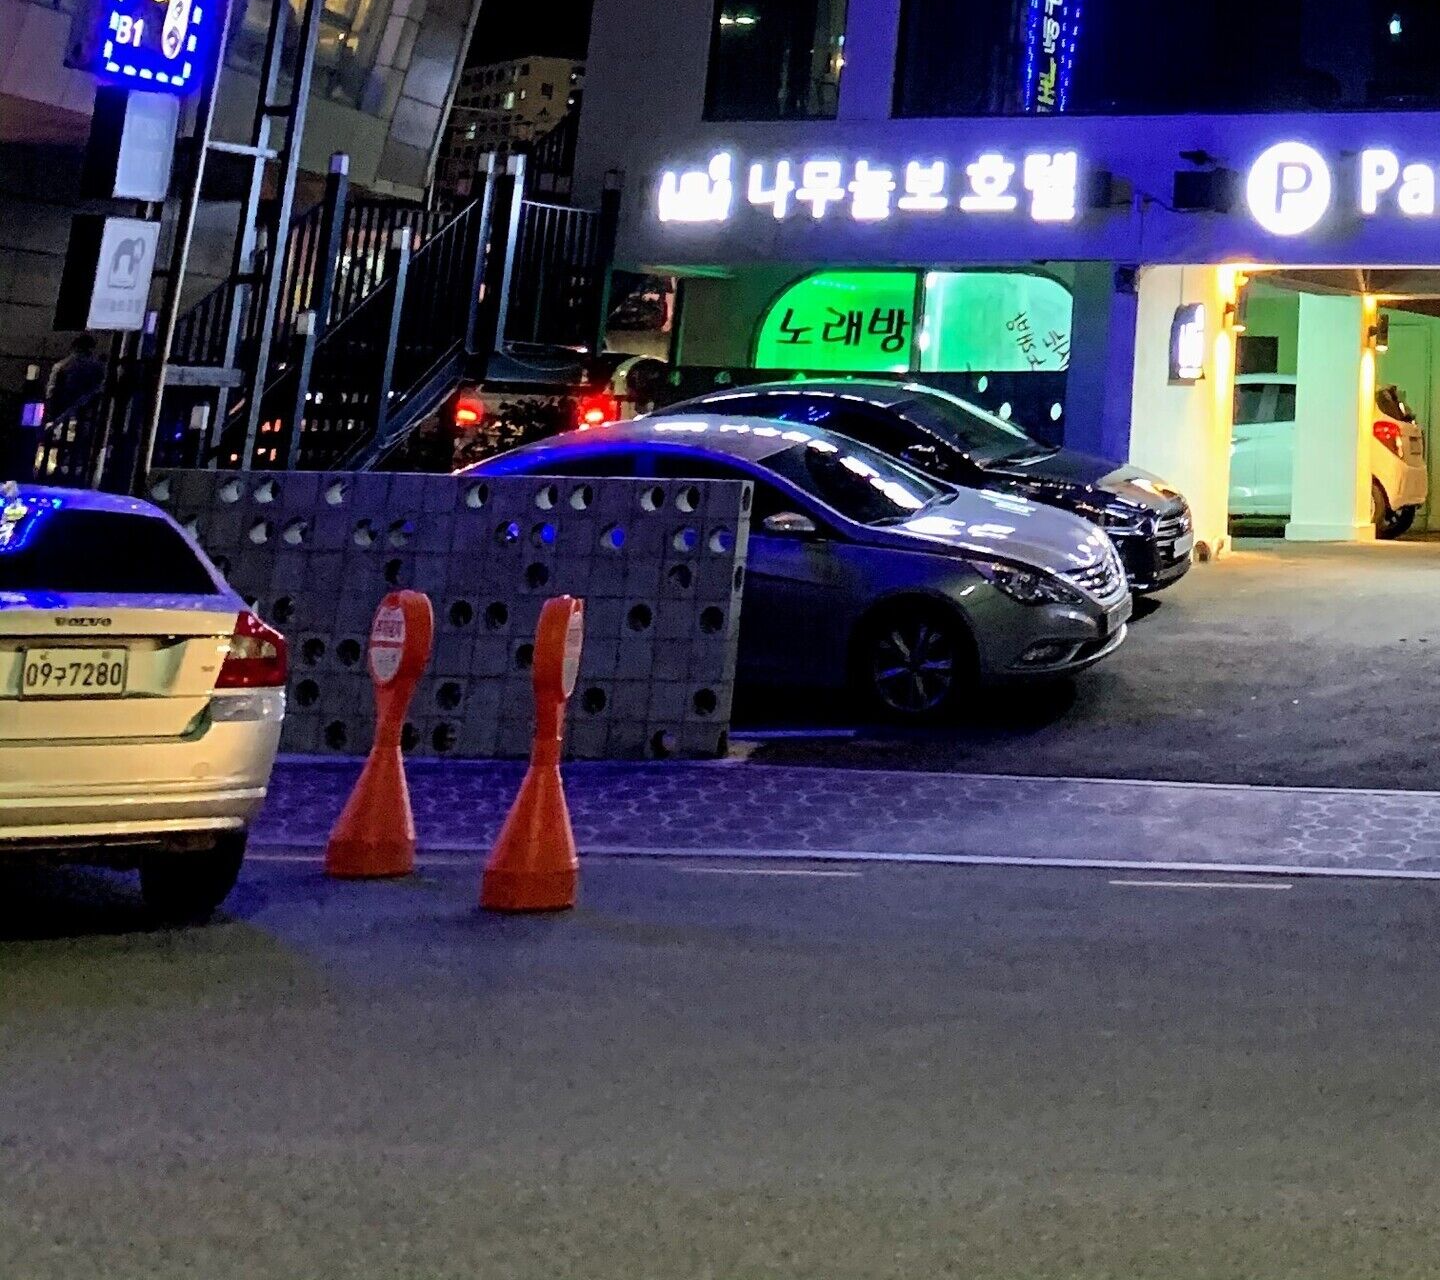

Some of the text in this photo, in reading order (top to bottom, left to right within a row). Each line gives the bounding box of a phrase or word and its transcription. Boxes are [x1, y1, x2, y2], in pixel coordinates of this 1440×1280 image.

[115, 14, 145, 49] B1
[775, 306, 911, 355] 노래방
[26, 662, 122, 687] 09구7280
